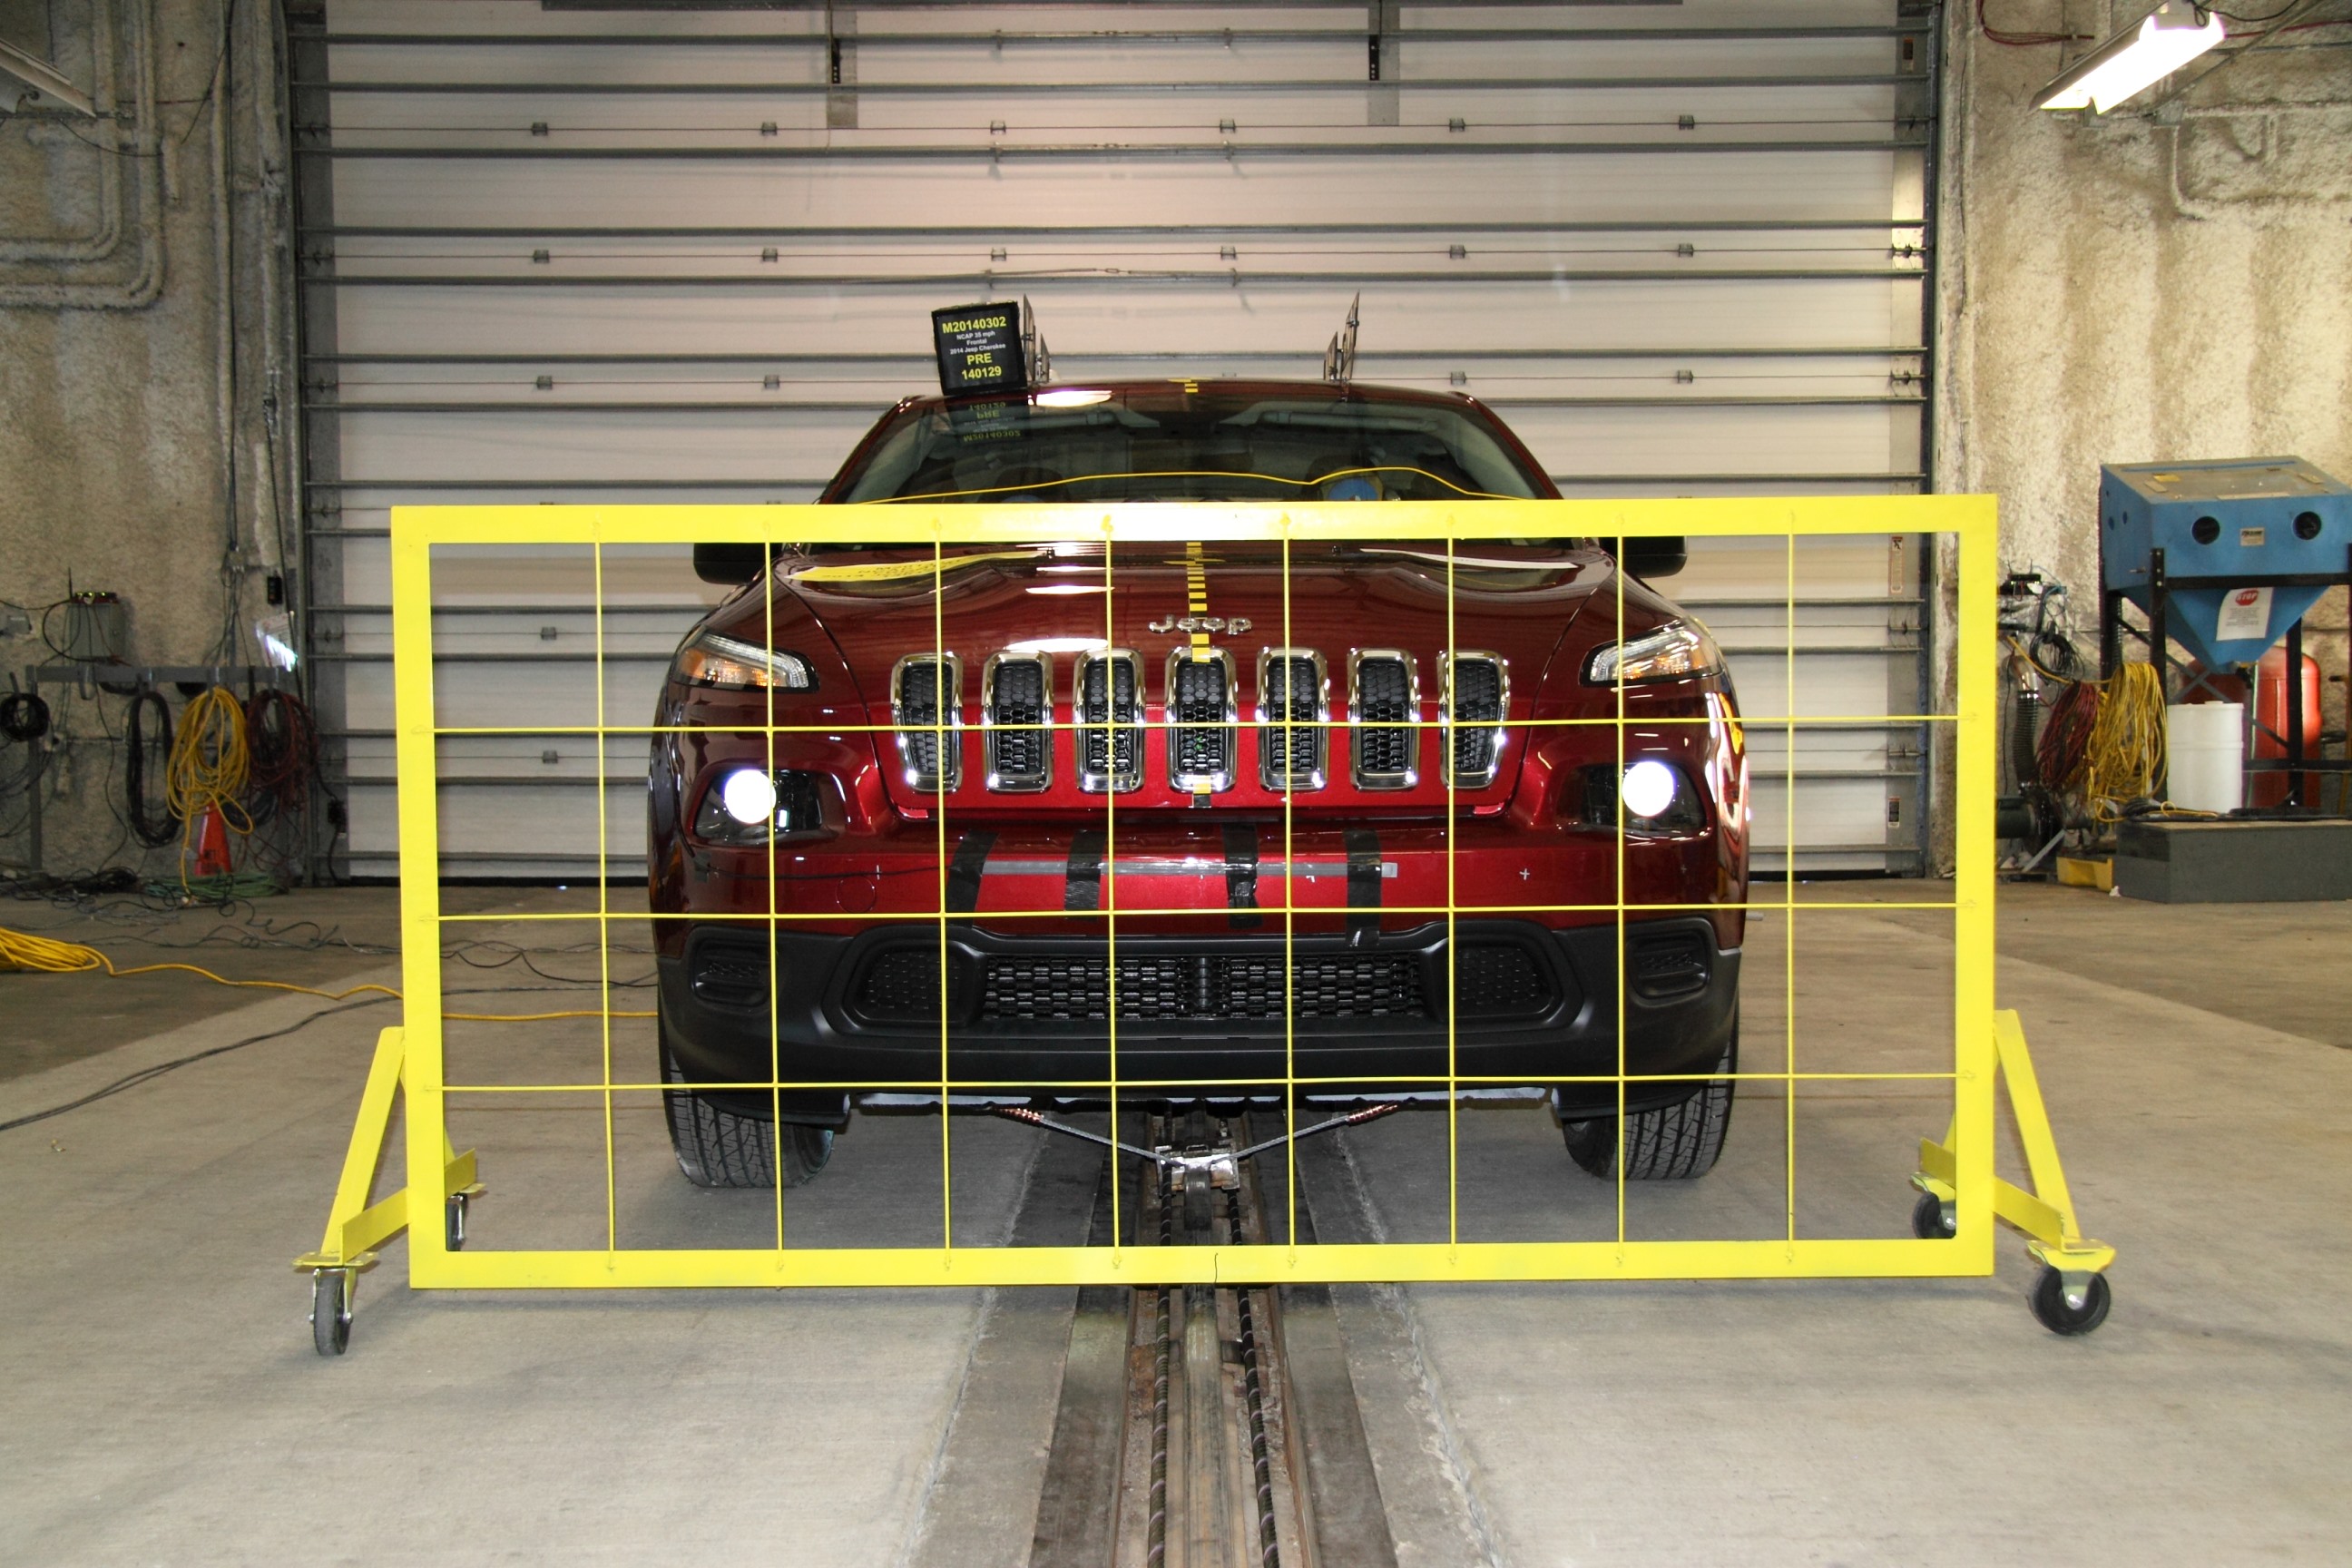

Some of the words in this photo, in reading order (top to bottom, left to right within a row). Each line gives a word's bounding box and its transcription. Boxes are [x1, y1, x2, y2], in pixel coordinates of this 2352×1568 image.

[942, 316, 1006, 334] M20140302
[956, 332, 974, 340] NCAP
[983, 330, 995, 338] mph
[979, 343, 1006, 351] Cherokee
[966, 353, 993, 365] PRE
[962, 366, 1002, 380] 140129
[2237, 592, 2258, 601] STOP
[1149, 614, 1252, 635] Jeep
